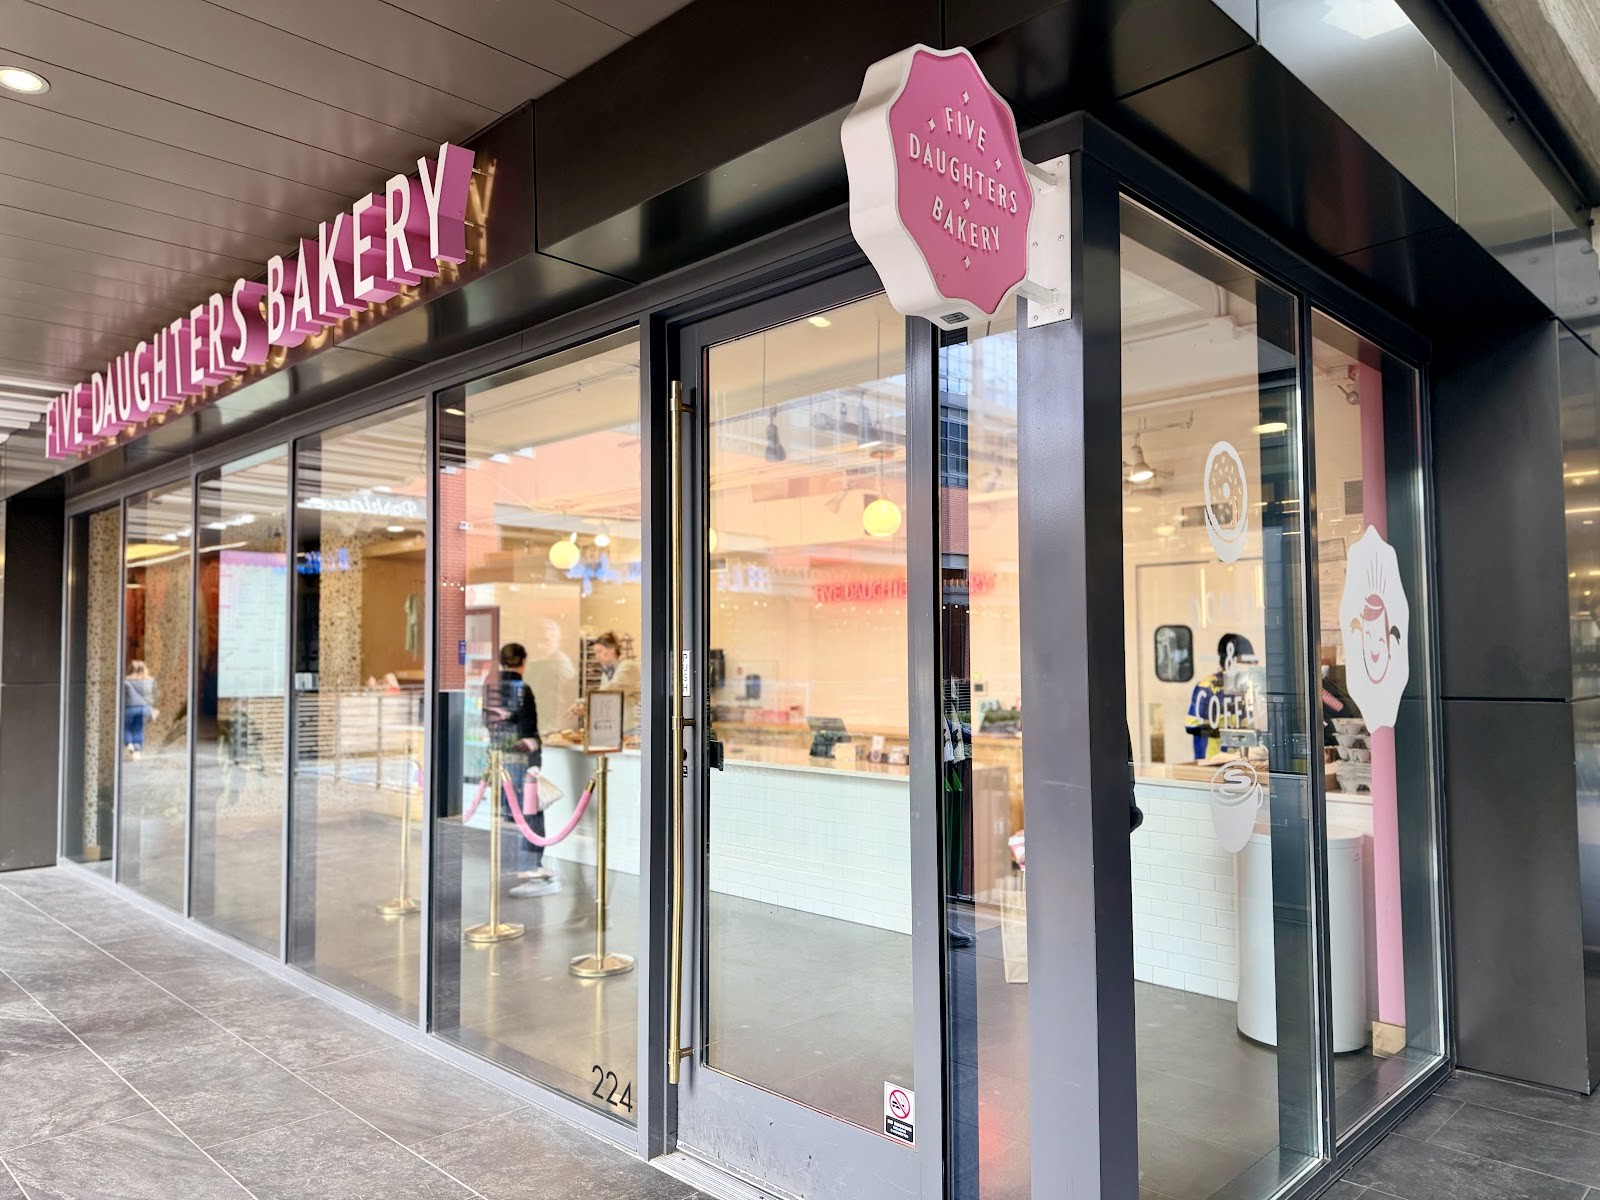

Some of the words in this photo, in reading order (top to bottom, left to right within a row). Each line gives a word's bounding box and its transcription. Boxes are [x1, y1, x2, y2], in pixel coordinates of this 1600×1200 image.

[943, 107, 986, 152] FIVE
[909, 132, 1018, 214] DAUGHTERS
[932, 196, 1000, 251] BAKERY
[45, 383, 83, 459] FIVE
[91, 277, 246, 436] DAUGHTERS
[267, 141, 448, 345] BAKERY
[815, 583, 842, 602] FIVE
[844, 578, 908, 600] DAUGHTE
[1195, 687, 1267, 730] COFFEE
[592, 1064, 633, 1112] 224
